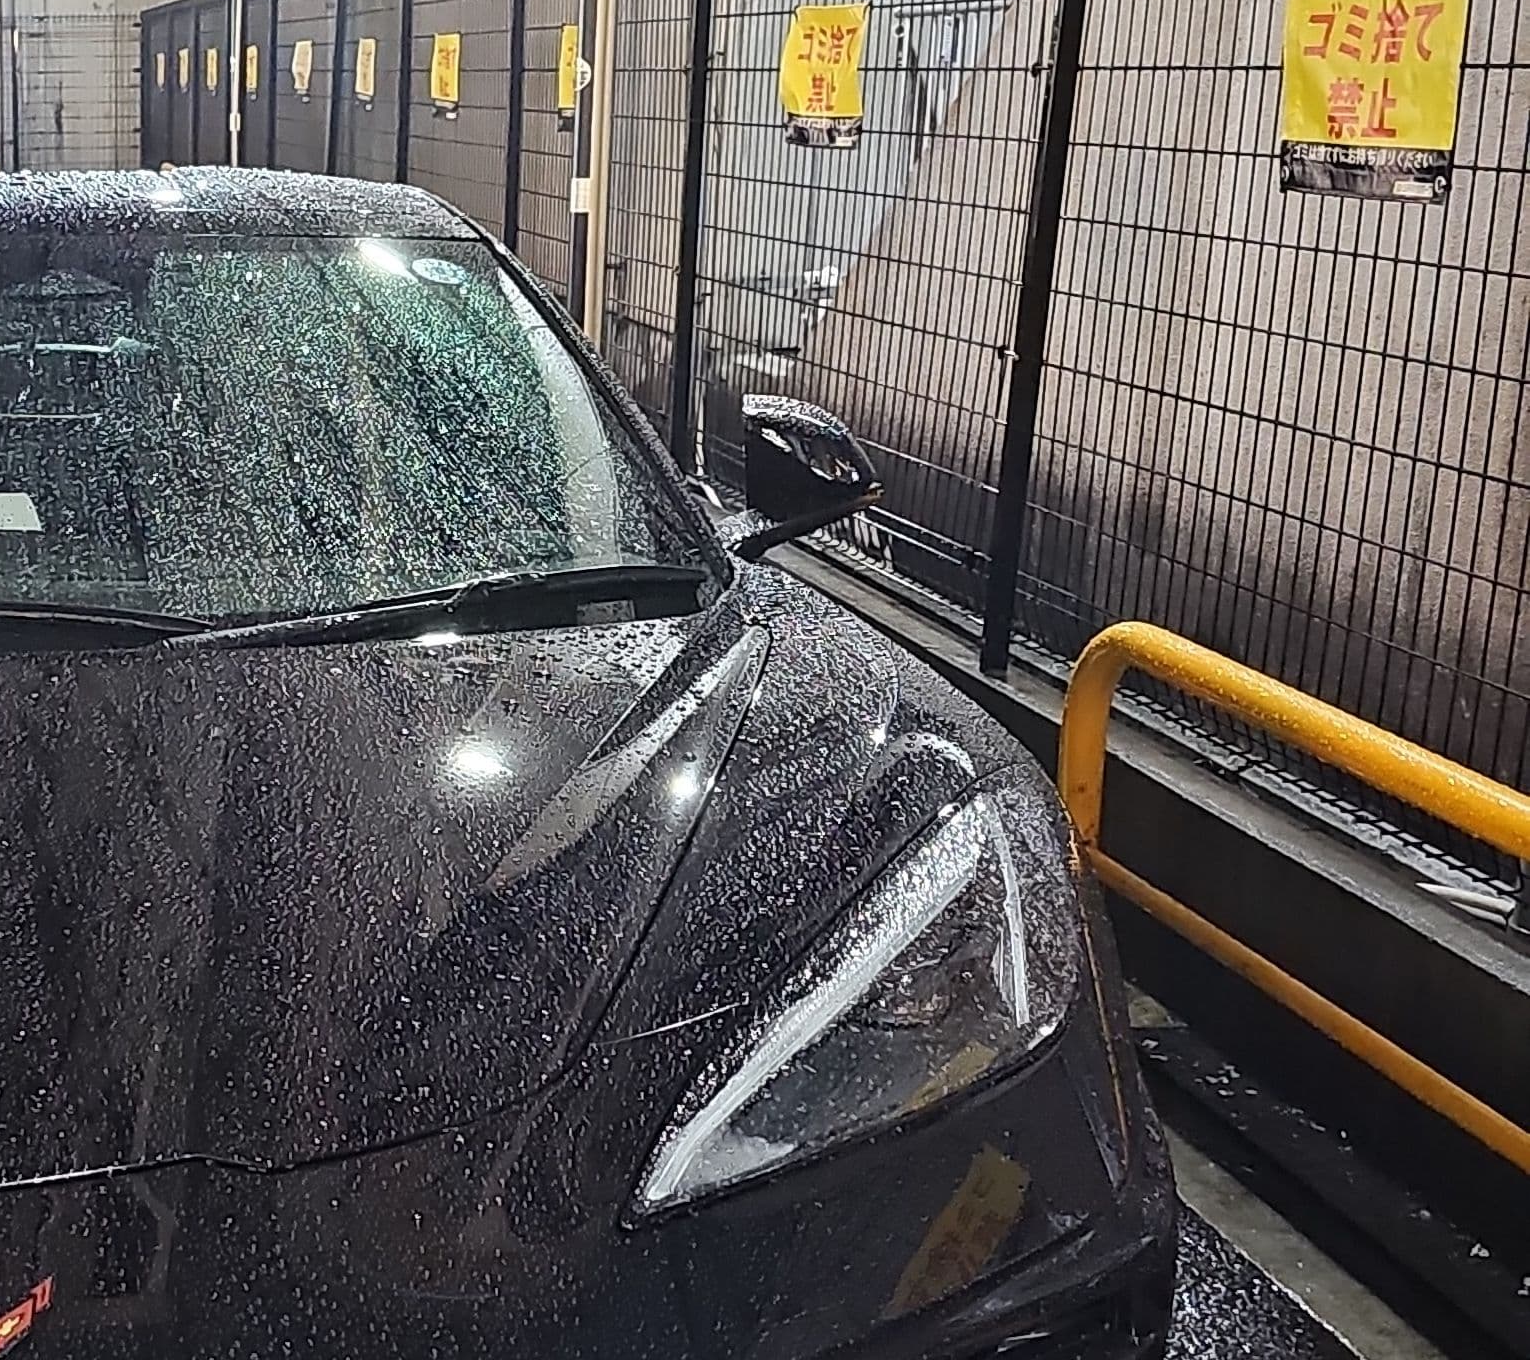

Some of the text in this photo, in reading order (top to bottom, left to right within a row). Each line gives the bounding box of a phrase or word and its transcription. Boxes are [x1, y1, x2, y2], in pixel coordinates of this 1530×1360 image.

[797, 24, 858, 64] ゴミ捨て
[805, 71, 836, 113] 禁止
[1326, 76, 1397, 140] 禁止
